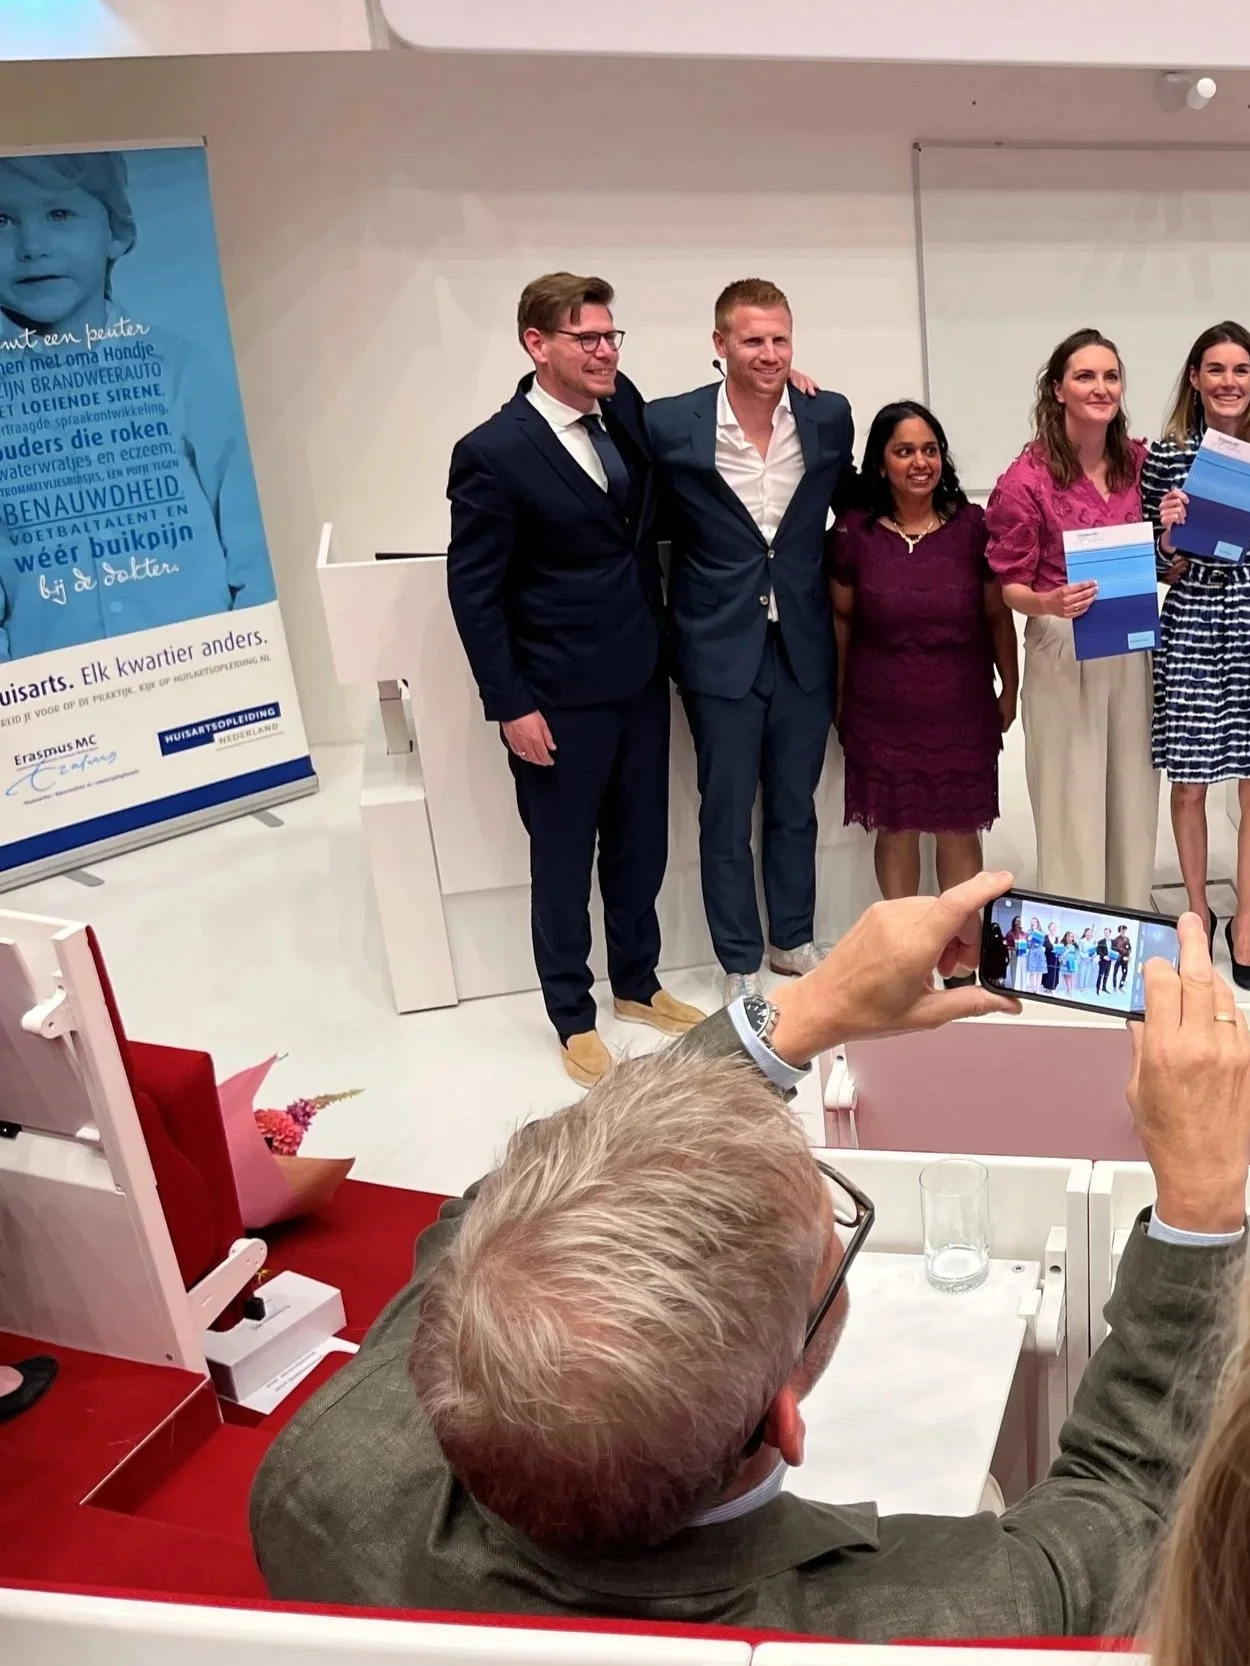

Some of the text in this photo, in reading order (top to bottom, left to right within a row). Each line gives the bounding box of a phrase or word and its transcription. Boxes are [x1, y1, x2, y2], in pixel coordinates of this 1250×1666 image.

[44, 332, 81, 346] een
[86, 316, 151, 351] peuter
[30, 353, 61, 372] met
[66, 351, 99, 367] oma
[103, 340, 154, 362] Hondje
[31, 361, 161, 394] BRANDWEERAUTO
[21, 391, 101, 415] LOEIENDE
[71, 428, 104, 449] die
[97, 451, 115, 465] en
[9, 503, 189, 547] VOETBALTALENT EN
[14, 521, 194, 574] wéér buikpijn
[39, 556, 180, 605] bij de dokter.
[81, 661, 111, 686] Elk
[115, 644, 193, 678] kwartier
[202, 630, 268, 657] anders.
[34, 704, 61, 718] VOOR
[63, 701, 76, 711] OP
[78, 697, 90, 708] DE
[159, 678, 171, 687] OP
[164, 707, 276, 744] HUISARTSOPLEIDING
[218, 722, 279, 745] NEDERLAND
[14, 734, 98, 766] Erasmus MC
